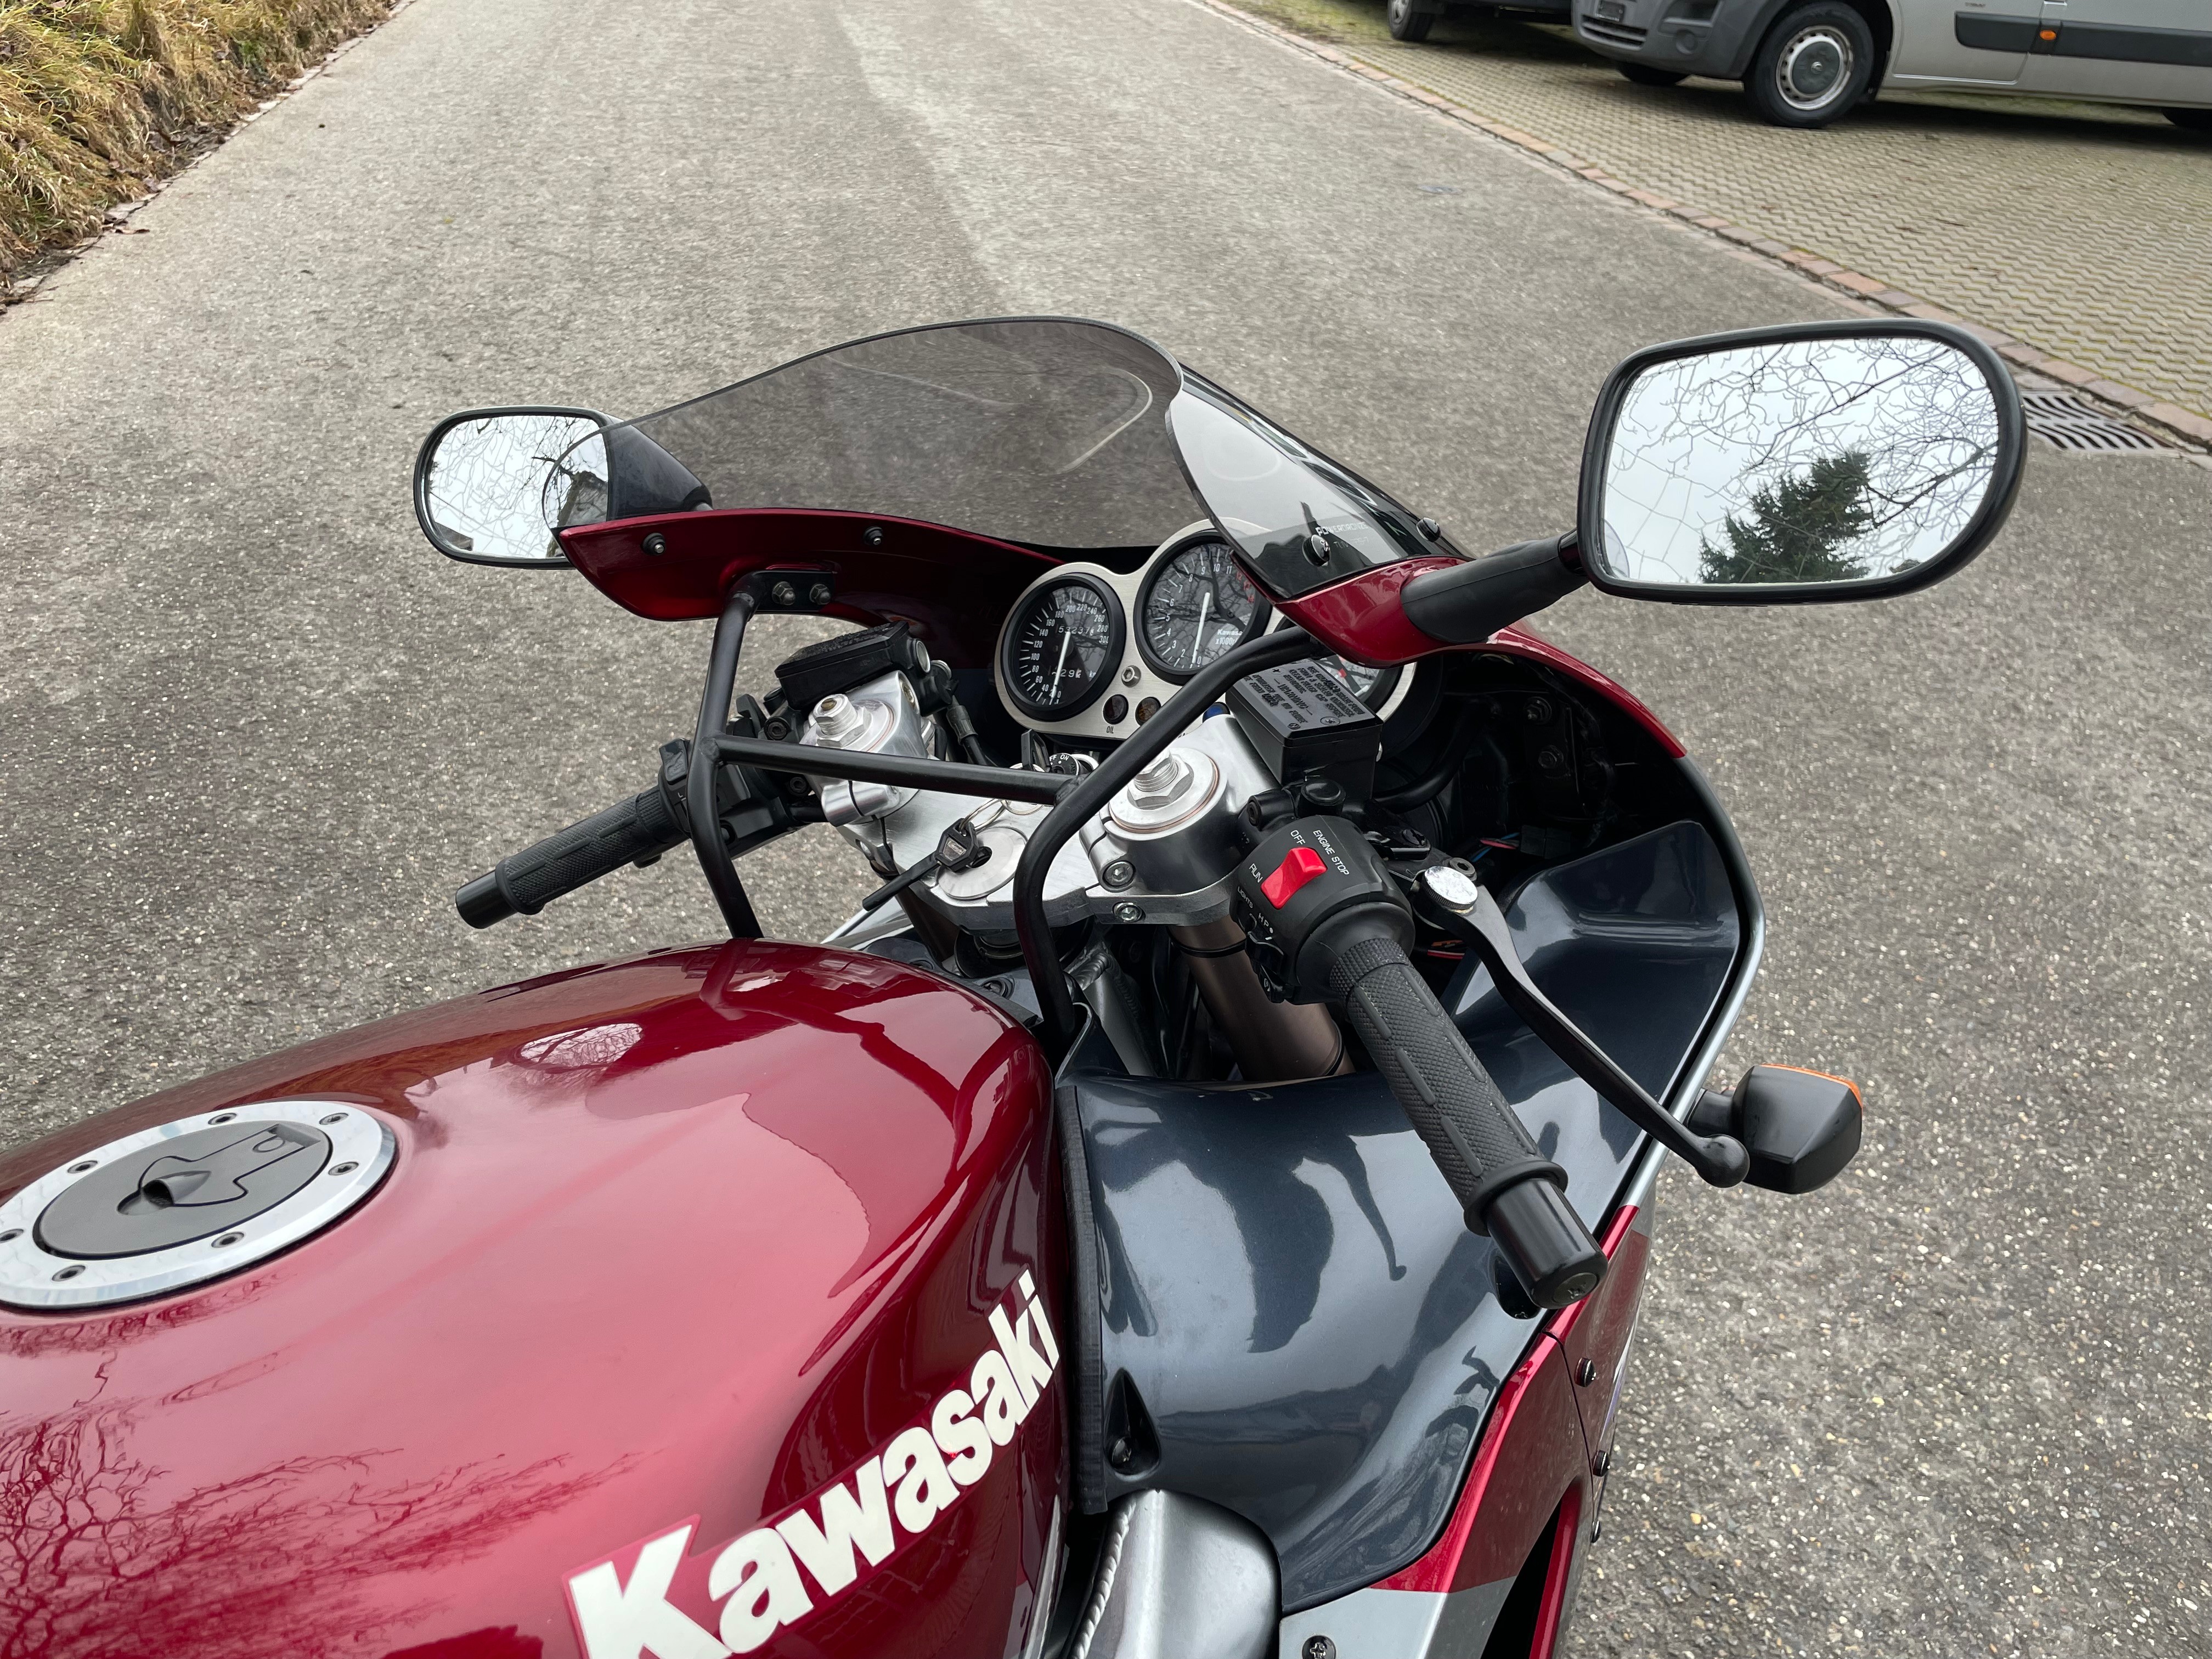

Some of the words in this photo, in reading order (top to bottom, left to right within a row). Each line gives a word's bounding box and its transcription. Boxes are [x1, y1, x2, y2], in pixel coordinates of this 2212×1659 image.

[1201, 566, 1206, 575] 9
[1213, 563, 1221, 572] 10
[1226, 566, 1232, 575] 11
[1188, 573, 1193, 582] 8
[1178, 584, 1183, 593] 7
[1170, 598, 1175, 607] 6
[1166, 613, 1171, 622] 5
[1166, 628, 1171, 636] 4
[1172, 640, 1177, 649] 3
[1181, 648, 1186, 658] 2
[1197, 656, 1201, 664] 0
[1106, 726, 1114, 734] OIL
[1290, 830, 1306, 845] OFF
[1313, 830, 1335, 855] ENGINE
[1331, 856, 1350, 875] STOP
[1249, 863, 1263, 883] RUN
[1237, 886, 1253, 909] LIGHTS
[569, 1269, 1060, 1659] Kawasaki
